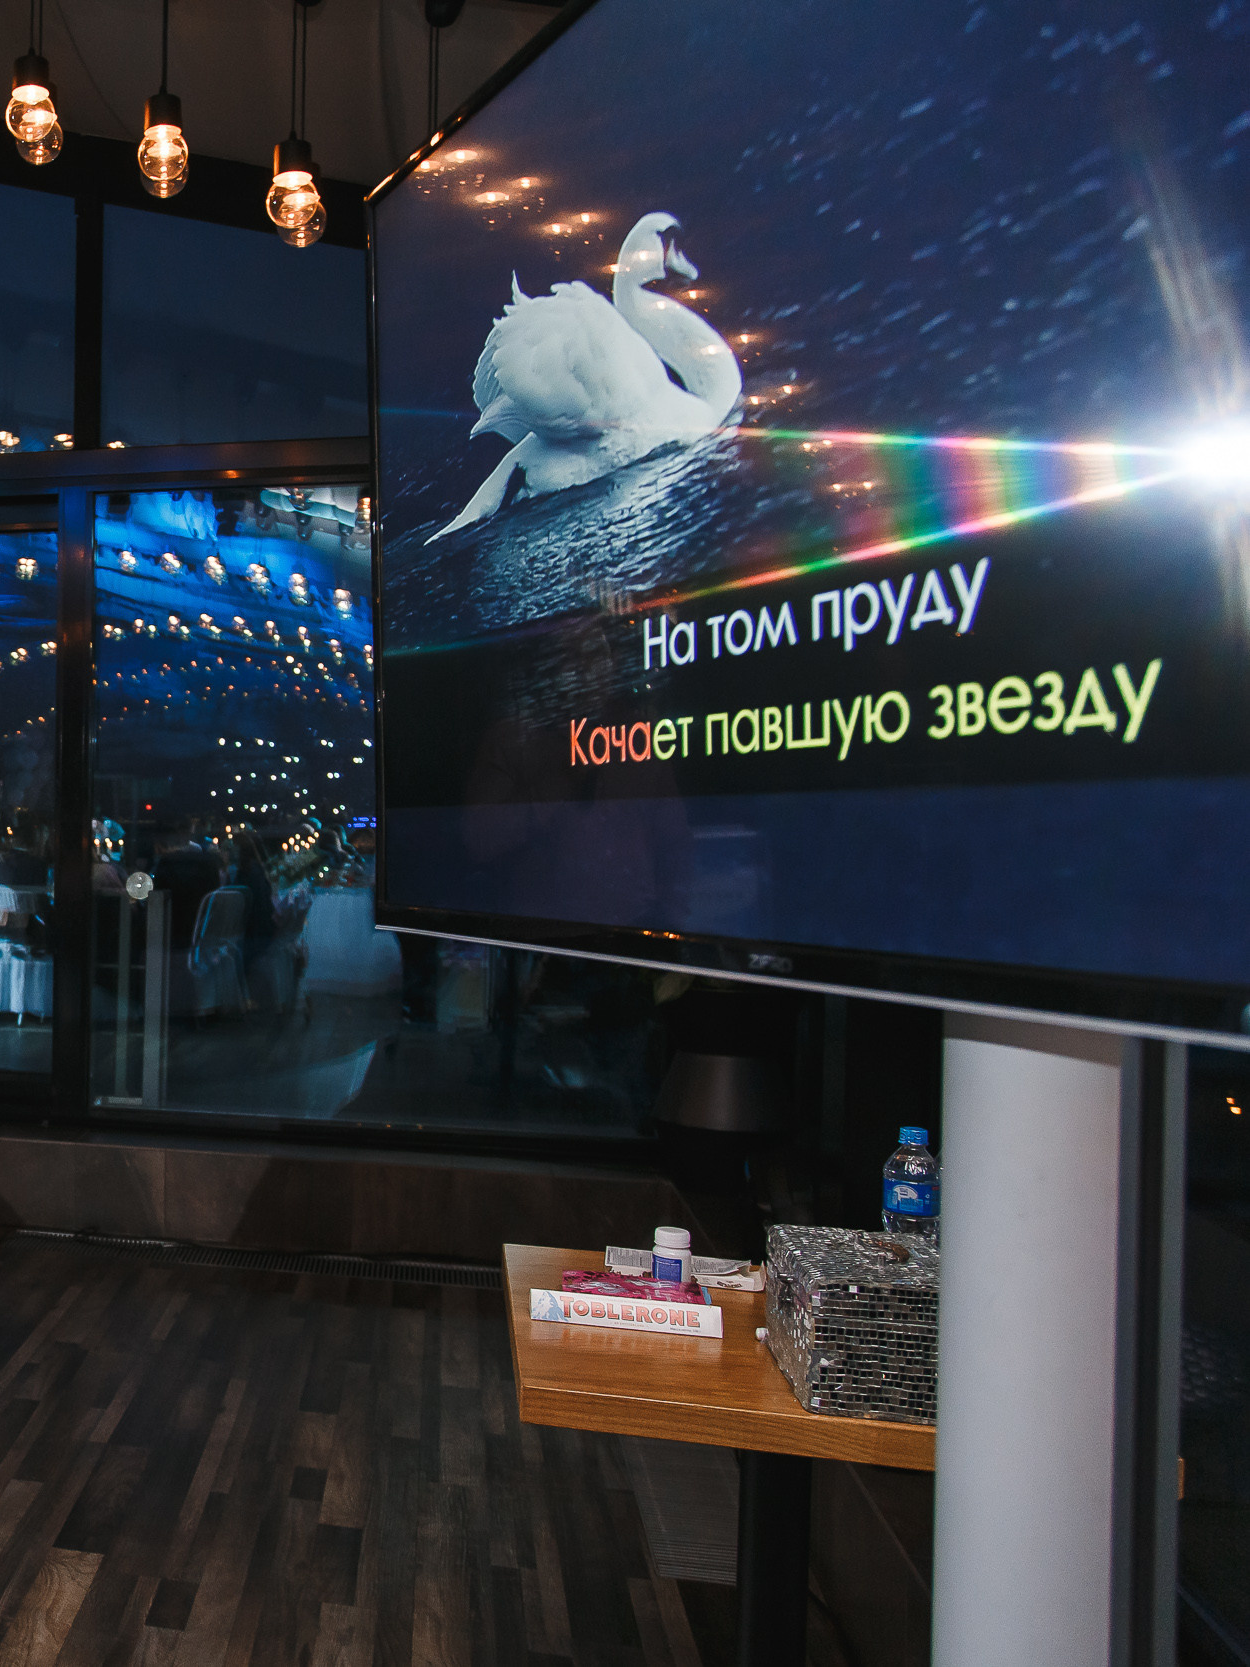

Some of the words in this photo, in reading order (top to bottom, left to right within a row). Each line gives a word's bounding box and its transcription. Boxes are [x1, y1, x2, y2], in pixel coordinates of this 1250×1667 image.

[642, 612, 696, 671] На
[706, 600, 798, 659] том
[810, 556, 991, 652] пруду
[569, 710, 694, 768] Качает
[704, 689, 912, 762] павшую
[926, 657, 1163, 744] звезду
[559, 1295, 701, 1328] TOBLERONE
